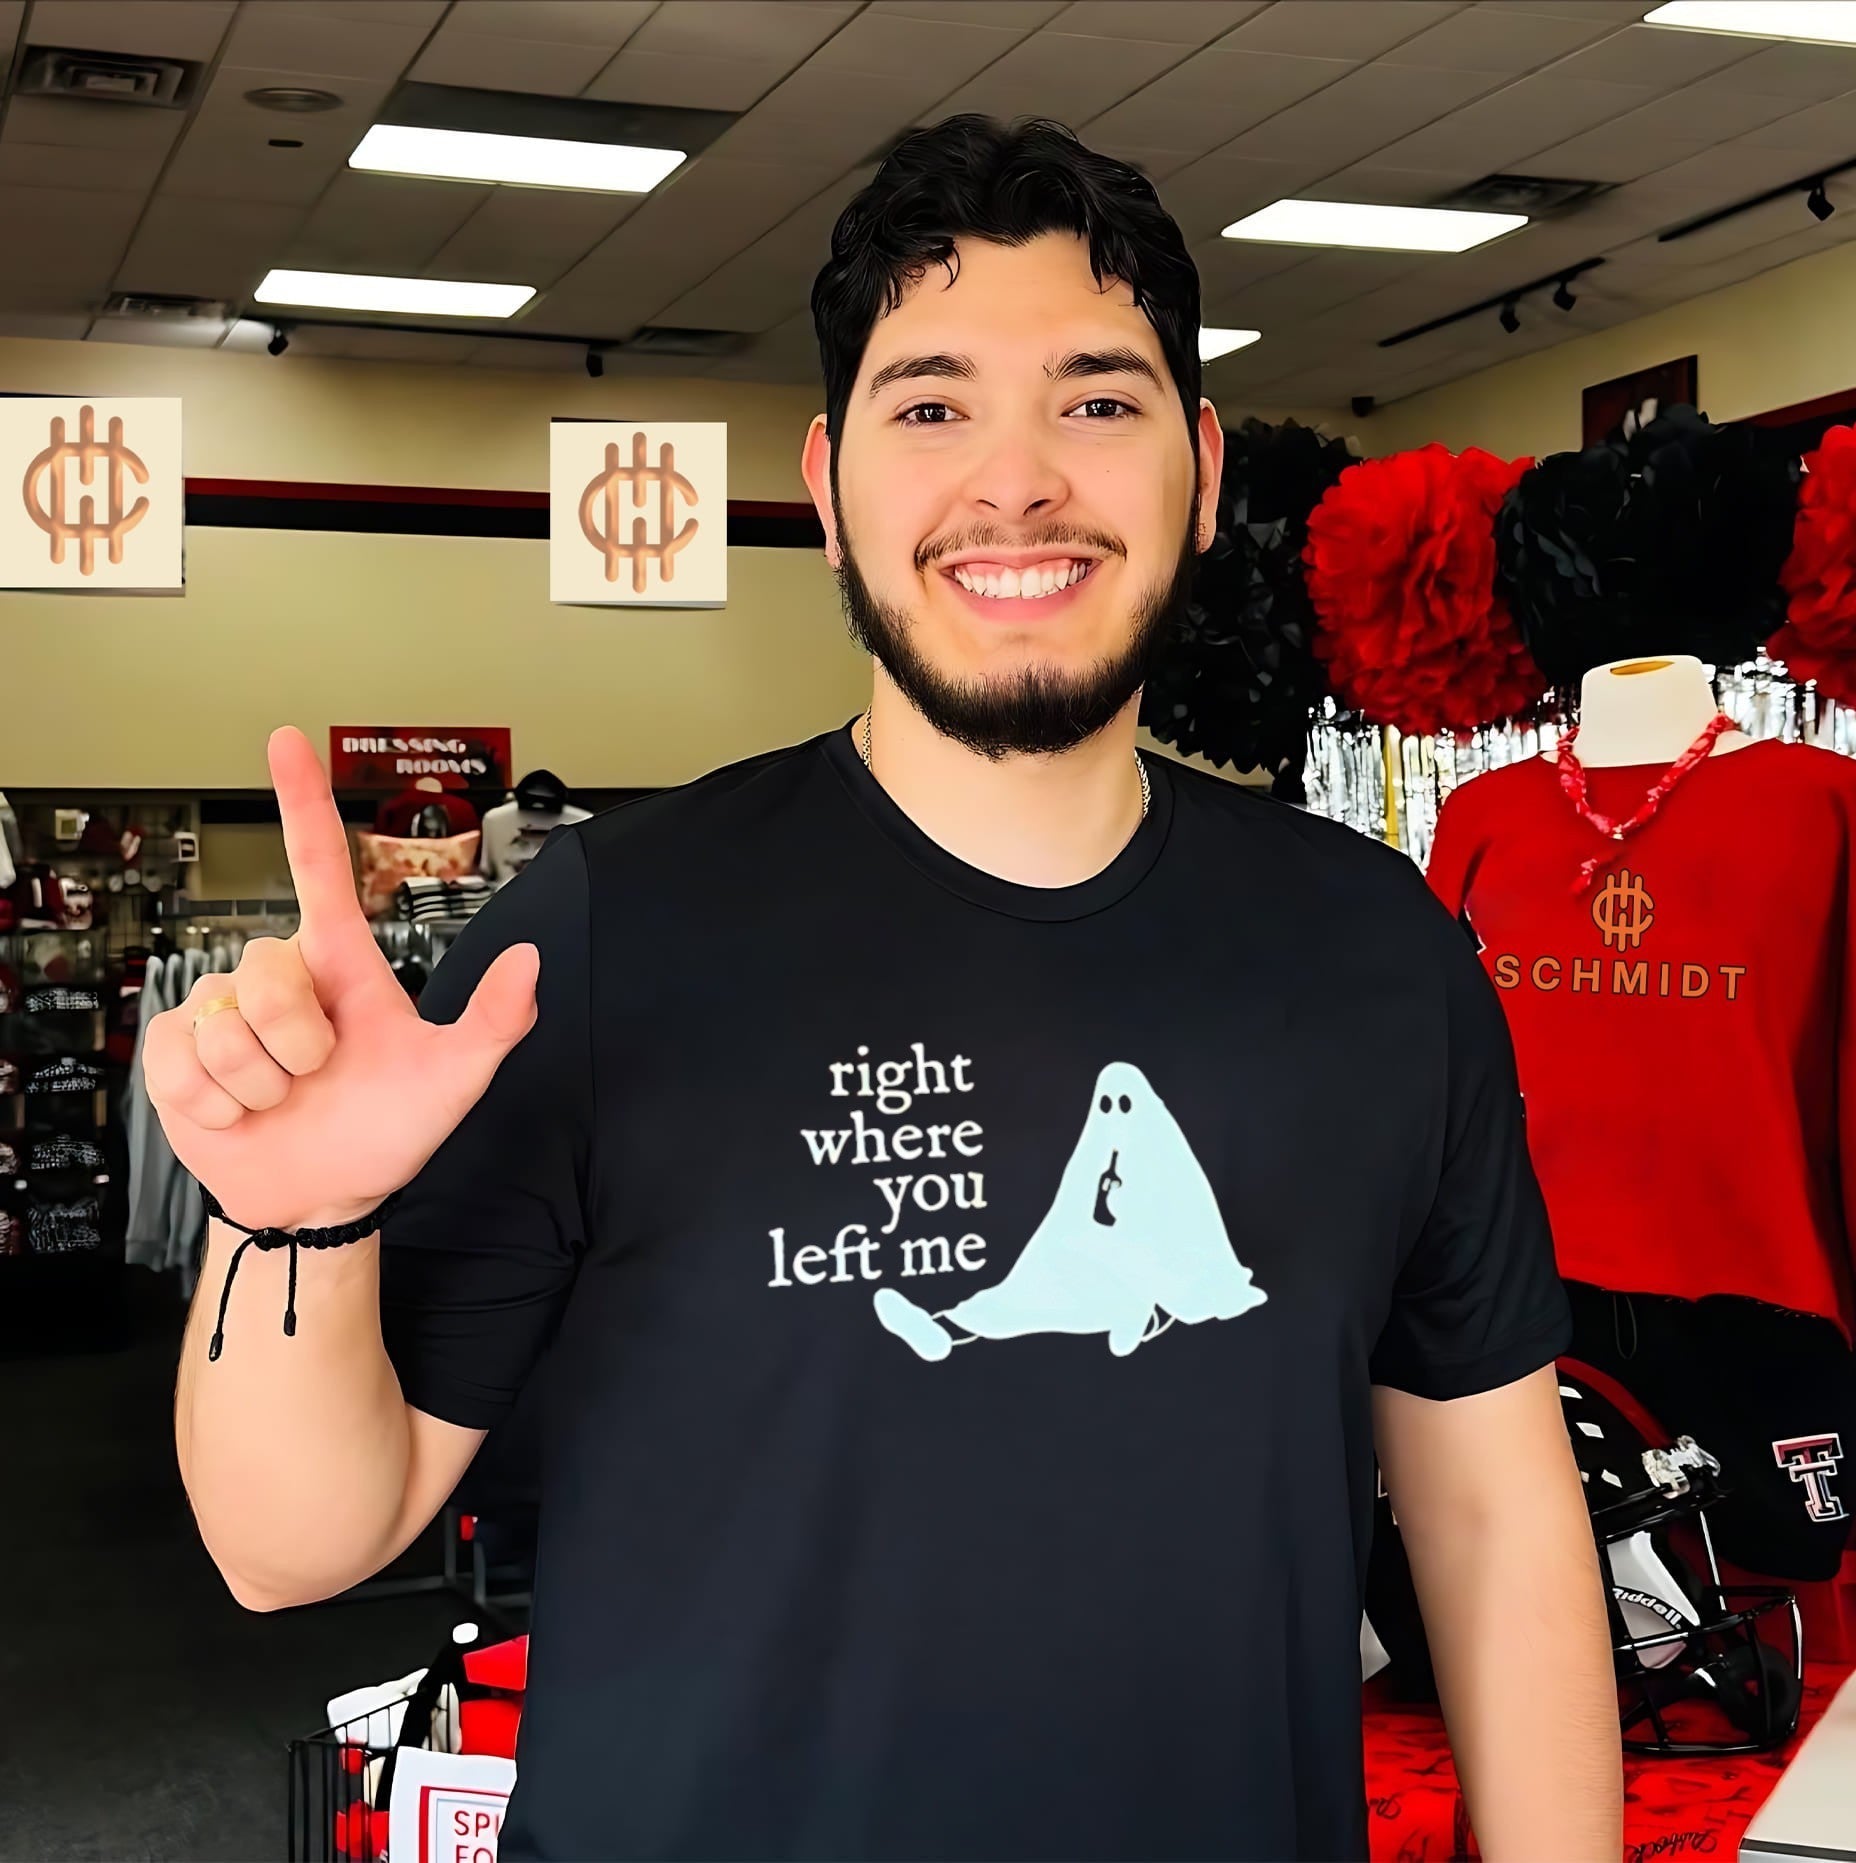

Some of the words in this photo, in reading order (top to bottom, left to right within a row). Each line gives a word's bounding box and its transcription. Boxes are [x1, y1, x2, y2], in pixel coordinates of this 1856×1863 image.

[341, 737, 467, 753] DRESSING
[396, 758, 487, 775] ROOMS
[1493, 953, 1747, 1000] SCHMIDT
[829, 1042, 975, 1115] right
[800, 1110, 984, 1165] where
[872, 1171, 988, 1234] you
[767, 1224, 883, 1287] left
[900, 1233, 987, 1277] me
